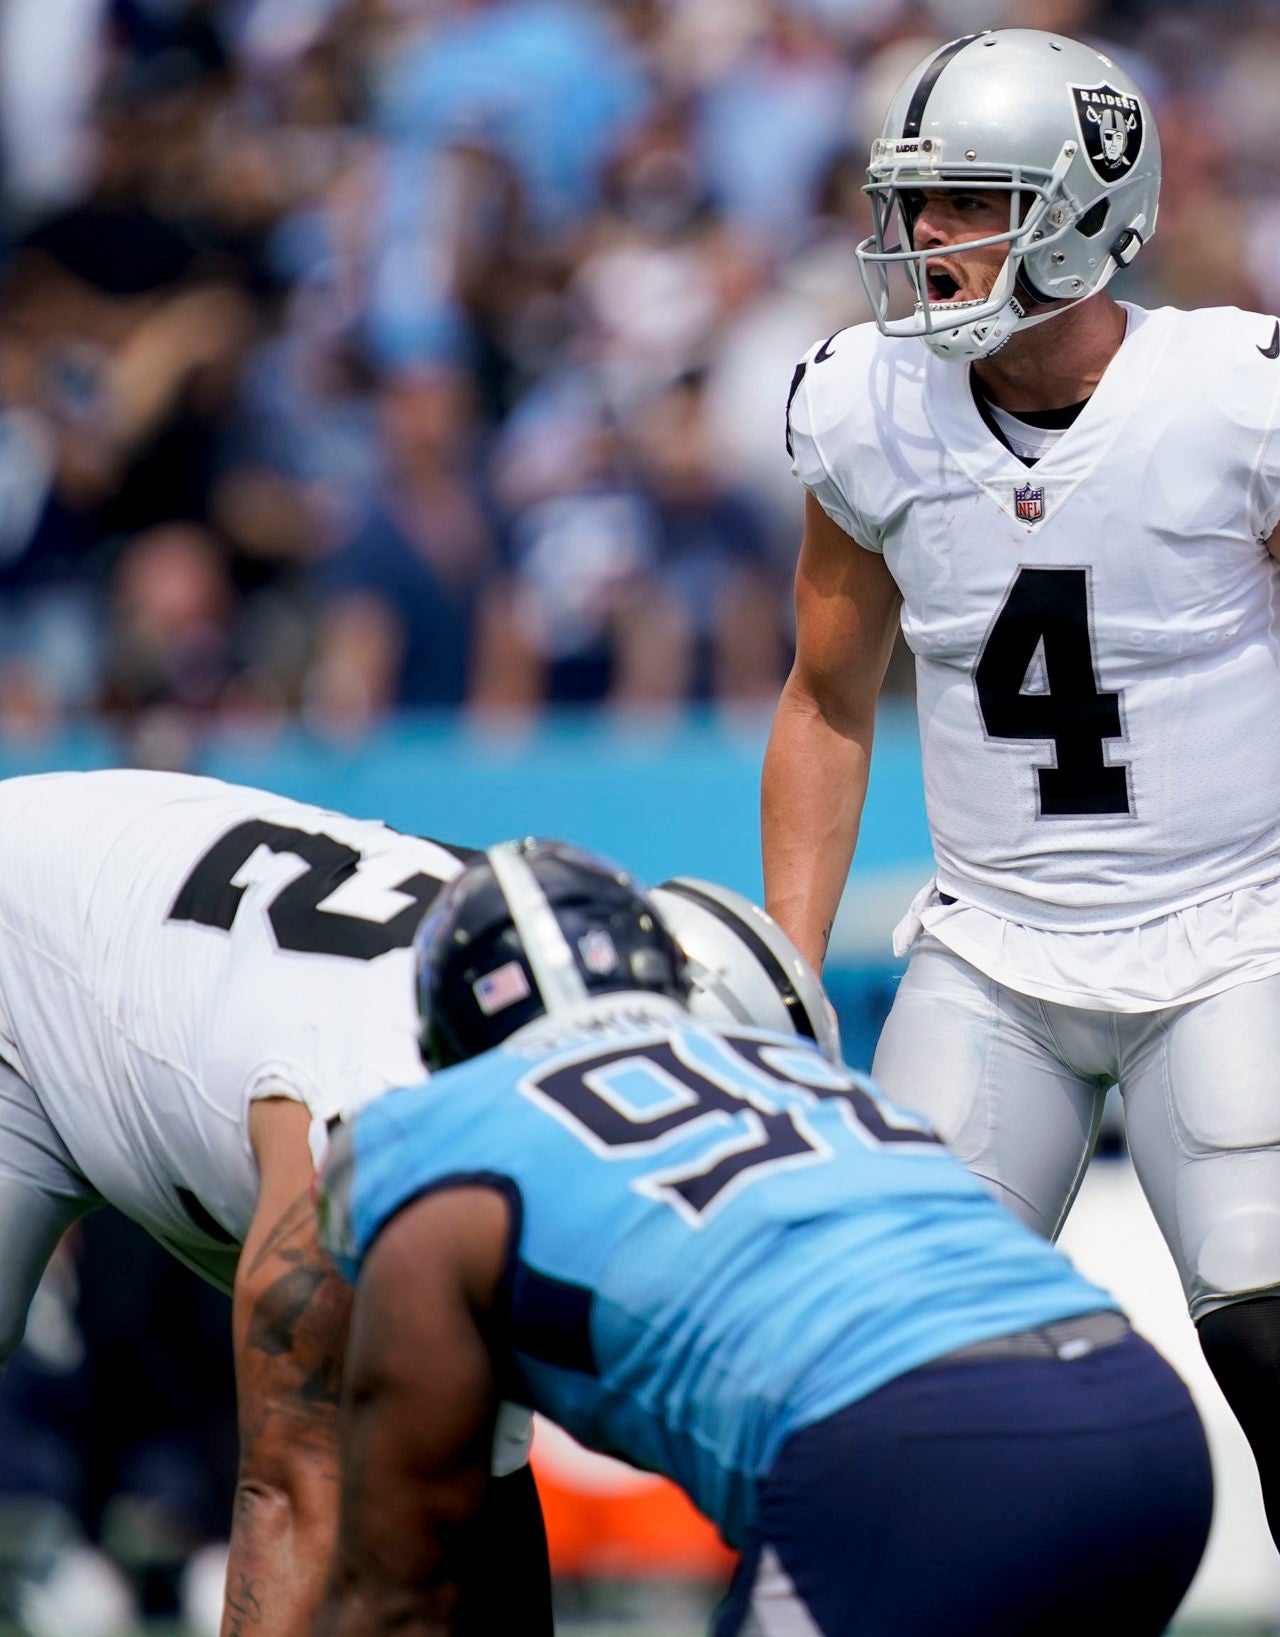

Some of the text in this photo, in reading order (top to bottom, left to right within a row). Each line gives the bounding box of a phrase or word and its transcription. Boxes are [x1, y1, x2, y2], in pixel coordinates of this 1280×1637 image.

[1080, 90, 1137, 111] RAIDERS
[895, 144, 919, 153] RAIDER
[1018, 501, 1040, 518] NFL
[971, 563, 1137, 822] 4
[163, 817, 468, 962] 2
